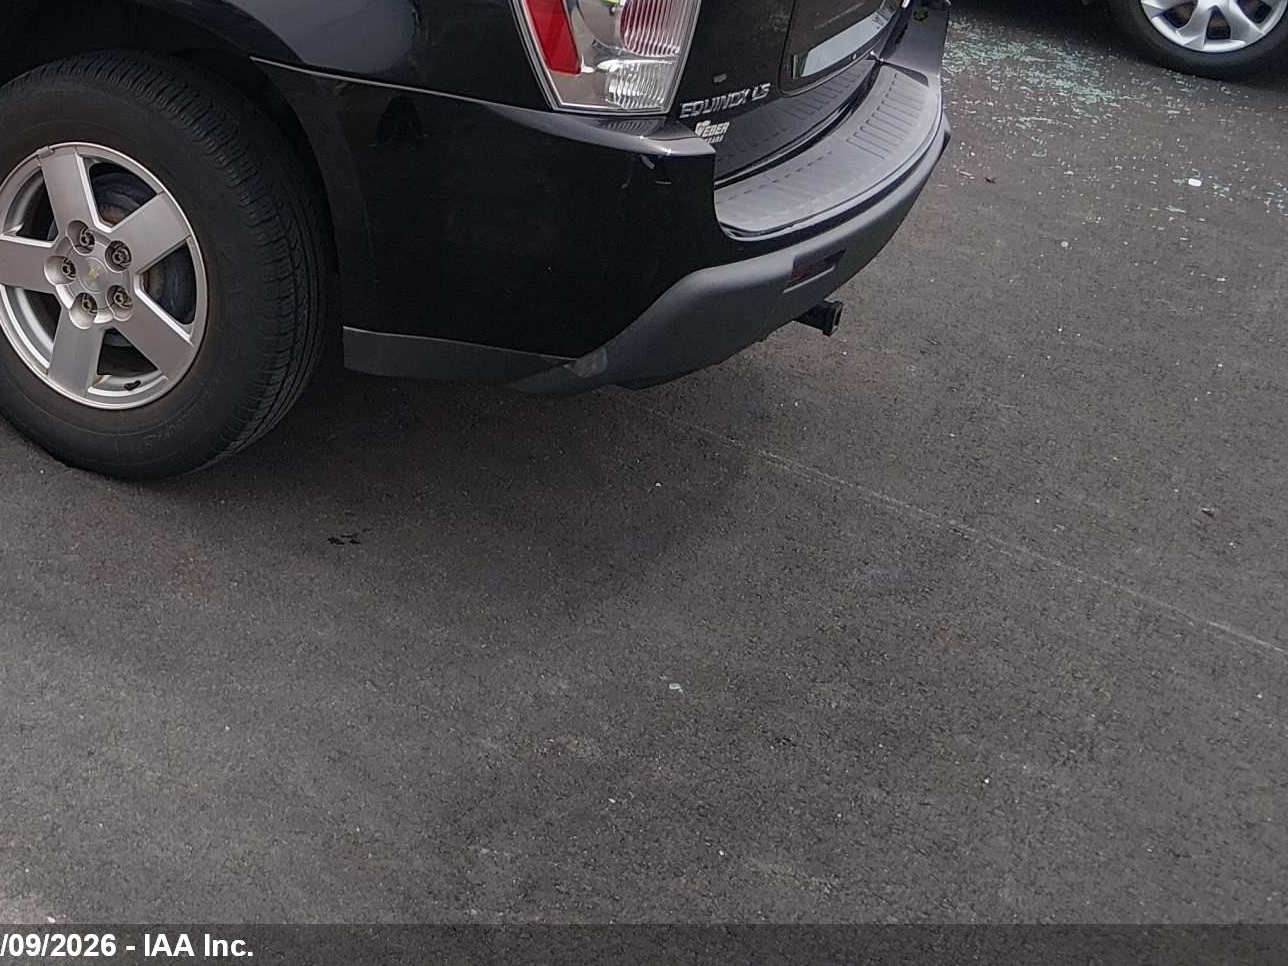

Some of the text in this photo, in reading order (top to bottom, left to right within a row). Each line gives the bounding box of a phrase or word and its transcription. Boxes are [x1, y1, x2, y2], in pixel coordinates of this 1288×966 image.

[679, 82, 771, 118] EQUINOX LS
[695, 120, 730, 138] WEBER
